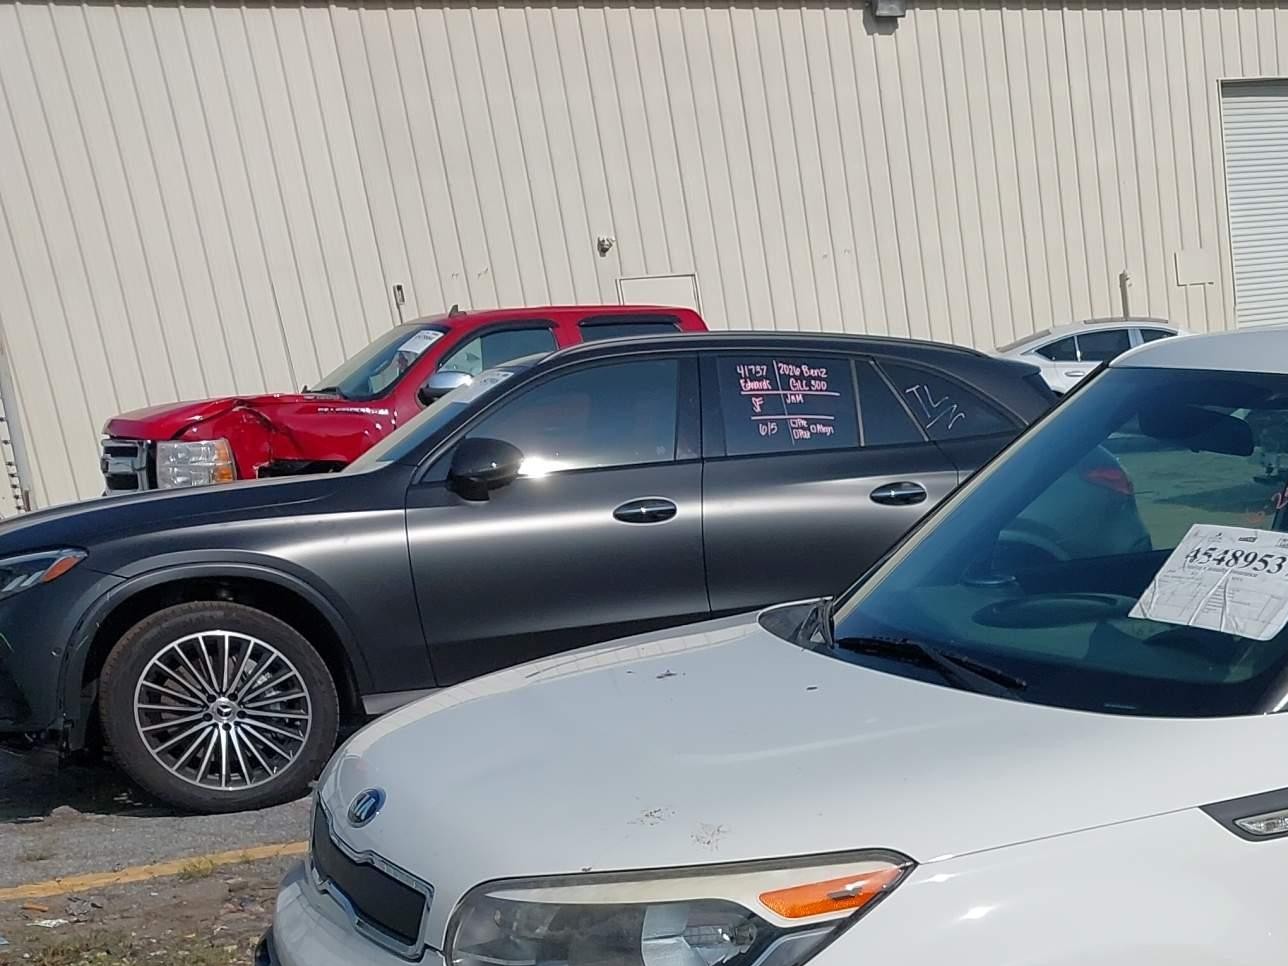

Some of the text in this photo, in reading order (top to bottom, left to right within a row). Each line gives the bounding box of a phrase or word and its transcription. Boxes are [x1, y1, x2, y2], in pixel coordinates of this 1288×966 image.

[736, 364, 768, 378] 41737
[777, 363, 828, 378] 2026 Benz
